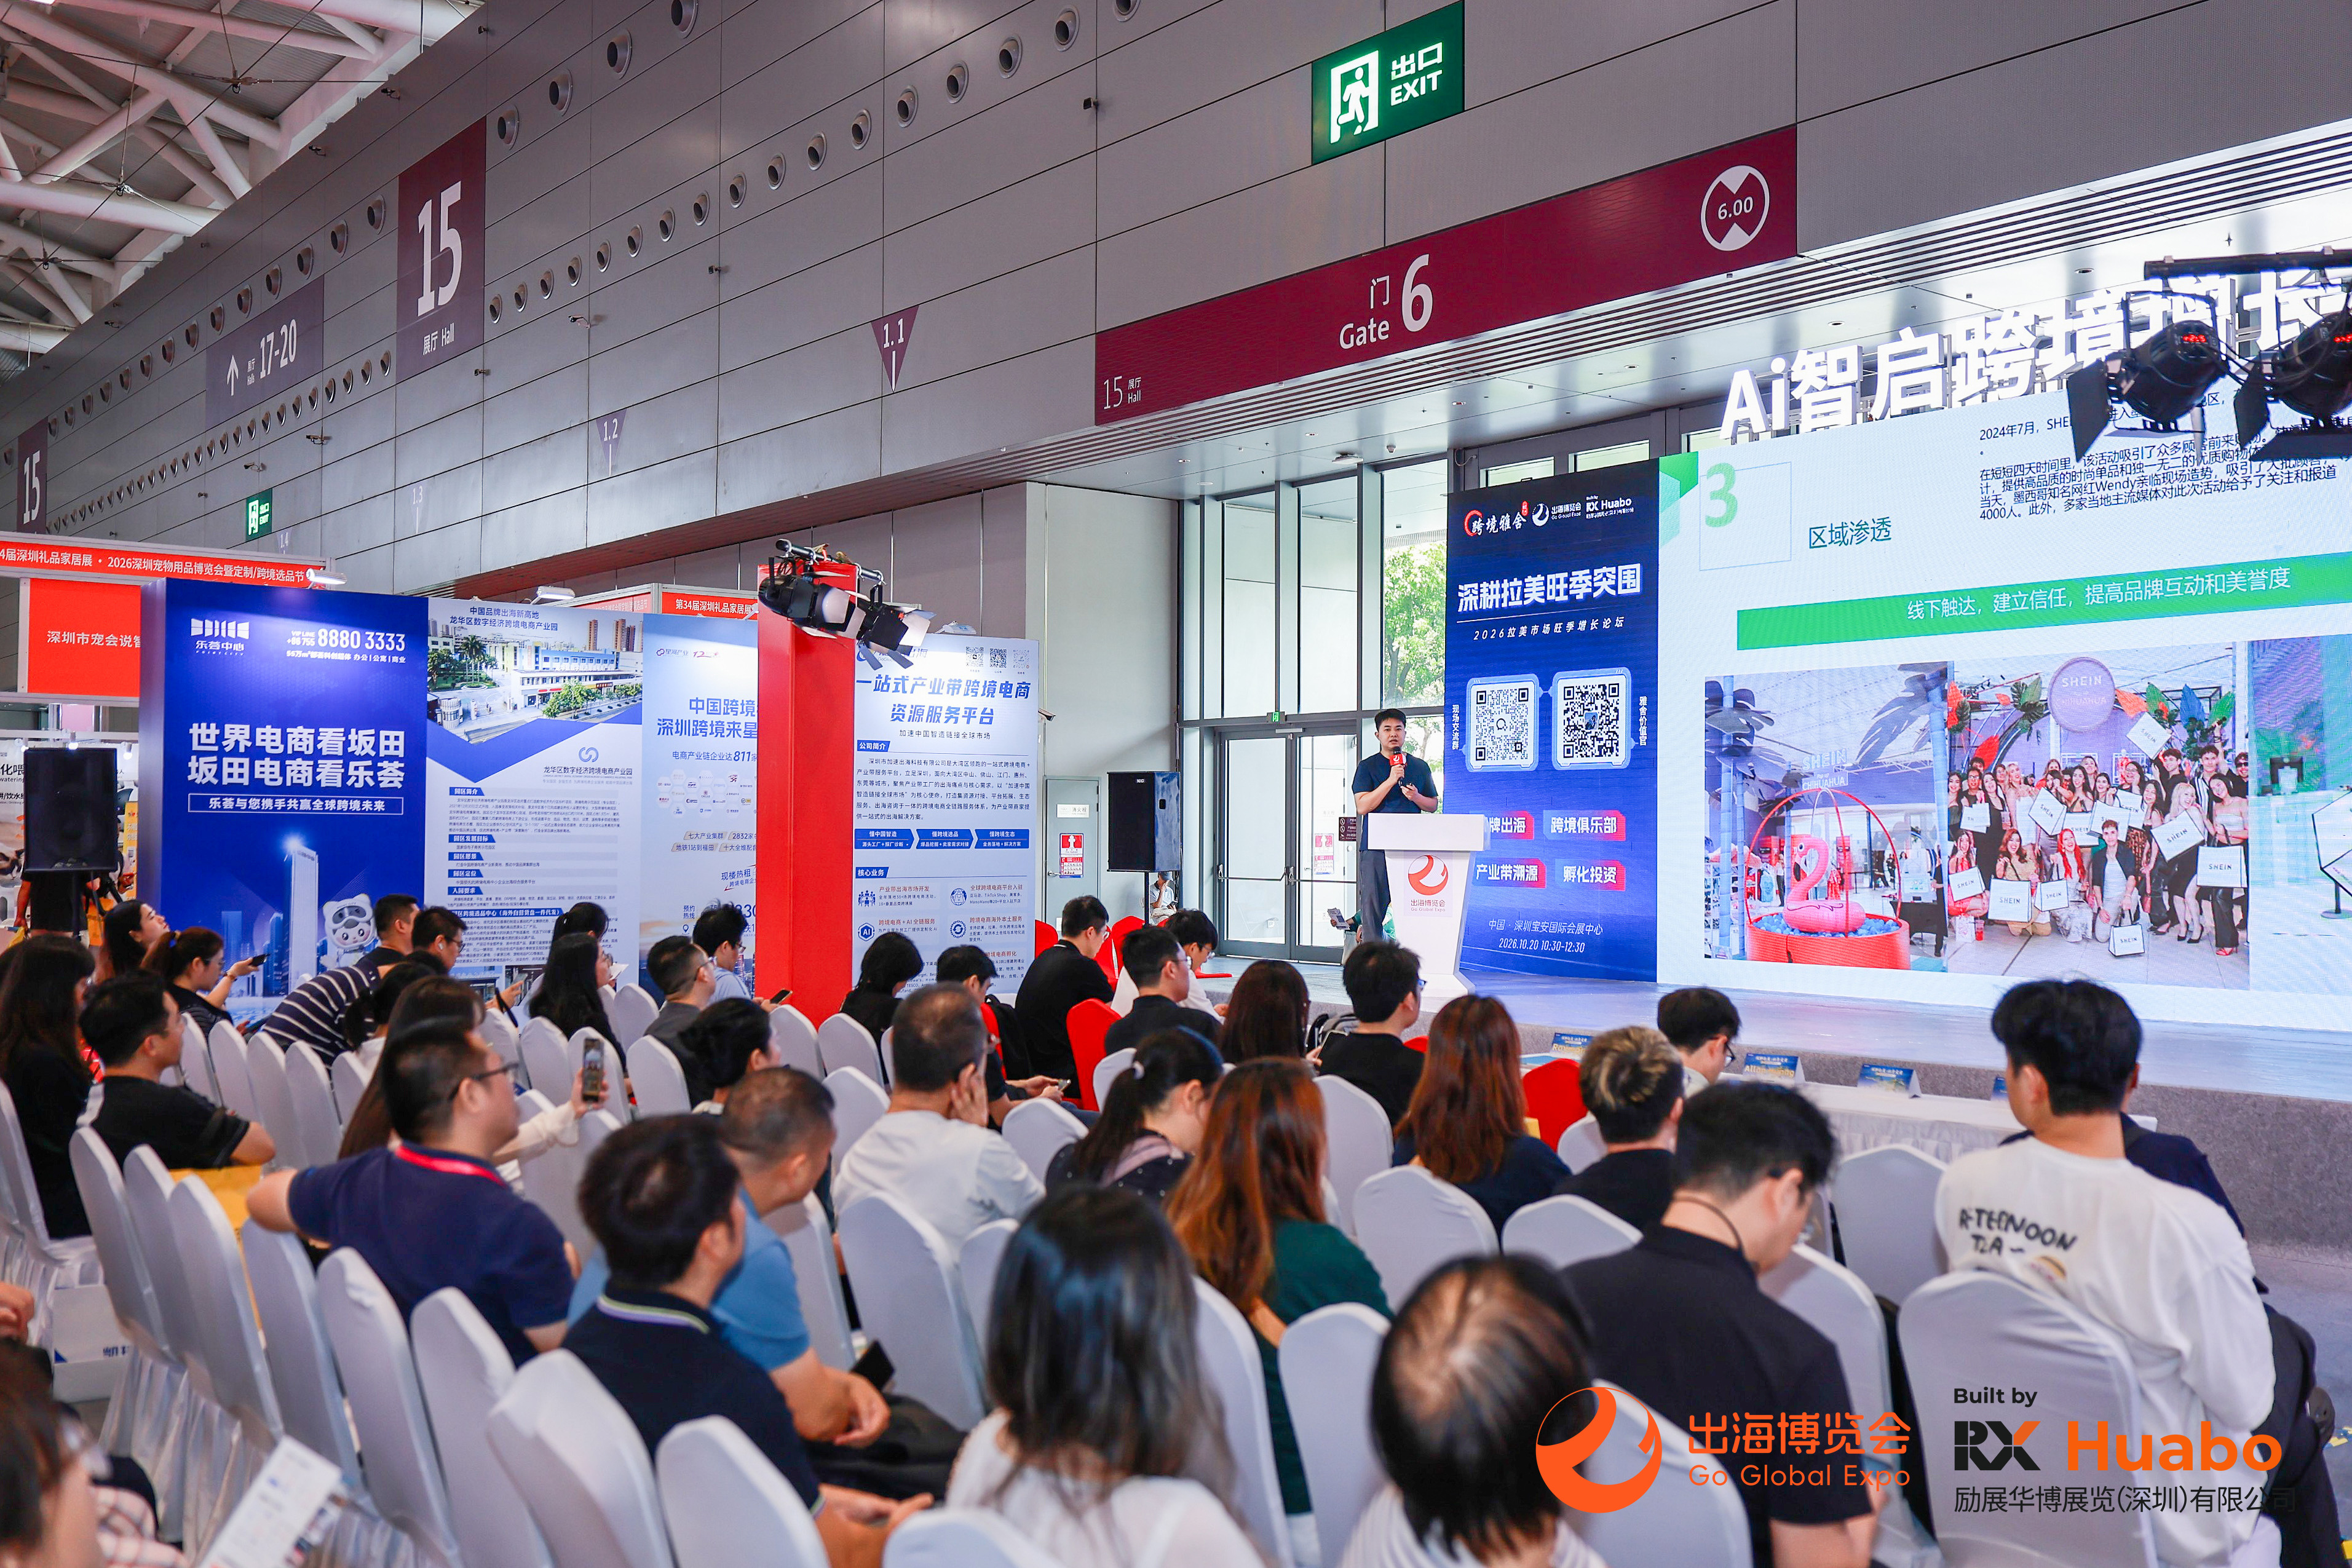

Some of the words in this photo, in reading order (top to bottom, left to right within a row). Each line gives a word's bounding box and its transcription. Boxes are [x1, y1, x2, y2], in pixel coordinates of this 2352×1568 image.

[1391, 42, 1443, 80] 出口
[1390, 70, 1443, 106] EXIT
[1717, 196, 1754, 221] 6.00
[418, 181, 462, 317] 15
[1371, 275, 1390, 309] 门
[1402, 254, 1433, 332] 6
[423, 331, 437, 355] 展厅
[441, 323, 454, 347] Hall
[883, 318, 904, 349] 1.1
[1339, 317, 1390, 349] Gate
[260, 319, 297, 379] 17-20
[1104, 376, 1123, 410] 15
[1128, 377, 1141, 390] 展厅
[1128, 390, 1141, 403] Hall
[604, 418, 618, 441] 1.2
[23, 450, 40, 524] 15
[413, 485, 423, 505] 1.3
[1705, 462, 1738, 528] 3
[1551, 502, 1582, 514] 出海博览会
[1601, 497, 1632, 510] Huabo
[1471, 512, 1526, 536] 跨境雅舍
[1809, 517, 1891, 548] 区域渗透
[1457, 563, 1642, 612] 深耕拉美旺季突围
[1907, 566, 2291, 620] 线下触达，建立信任，提高品牌互动和美誉度
[470, 606, 539, 619] 中国品牌出海新高地
[449, 616, 558, 631] 龙华区数字经济跨境电商产业园
[1473, 616, 1625, 640] 2026拉美市场旺季增长论坛
[196, 640, 245, 651] 乐荟中心
[318, 628, 361, 649] 8880
[365, 632, 405, 652] 3333
[857, 674, 1031, 699] 一站式产业带跨境电商
[2062, 675, 2102, 687] SHEIN
[689, 697, 756, 717] 中国跨境
[890, 703, 994, 725] 资源服务平台
[657, 718, 758, 738] 深圳跨境来星
[1639, 696, 1647, 746] 雅舍价值官
[189, 723, 405, 758] 世界电商看坂田
[899, 729, 991, 740] 加速中国智造链接全球市场
[860, 742, 886, 751] 公司简介
[1802, 749, 1847, 770] SHEIN
[188, 755, 405, 789] 坂田电商看乐荟
[544, 766, 633, 775] 龙华区数字经济跨境电商产业园
[1802, 777, 1845, 791] CHIHUAHUA
[208, 798, 385, 812] 乐荟与您携手共赢全球跨境未来
[1487, 816, 1526, 834] 牌出海
[1551, 817, 1617, 834] 跨境俱乐部
[2166, 828, 2188, 844] SHEIN
[721, 869, 751, 881] 现楼热租
[729, 878, 756, 887] 跨境电商企
[1476, 863, 1538, 881] 产业带溯源
[1563, 865, 1617, 884] 孵化投资
[1957, 879, 1974, 889] SHEIN
[1488, 919, 1505, 930] 中国
[1514, 919, 1603, 936] 深圳宝安国际会展中心
[1499, 937, 1538, 951] 2026.10.20
[1541, 938, 1585, 953] 10:30-12:30
